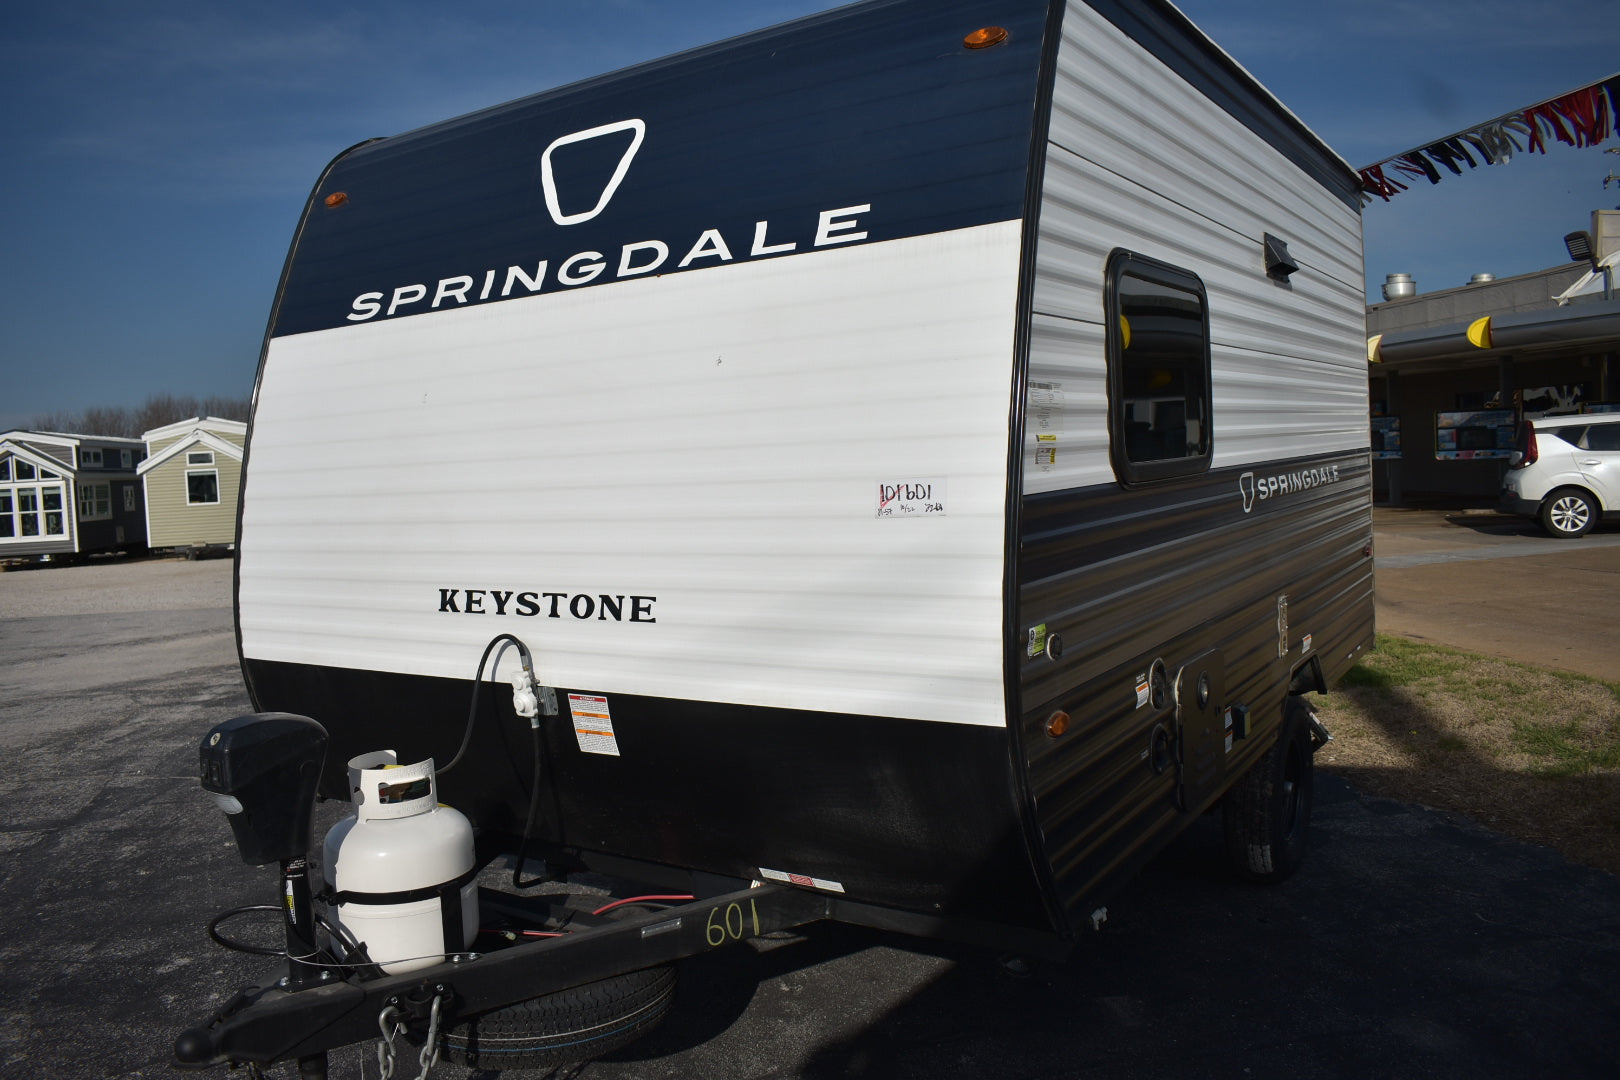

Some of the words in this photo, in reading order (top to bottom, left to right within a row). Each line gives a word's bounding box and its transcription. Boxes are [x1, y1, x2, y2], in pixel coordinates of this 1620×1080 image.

[346, 203, 871, 322] SPRINGDALE
[1257, 465, 1340, 500] SPRINGDALE
[438, 588, 657, 623] KEYSTONE
[706, 897, 760, 947] 601
